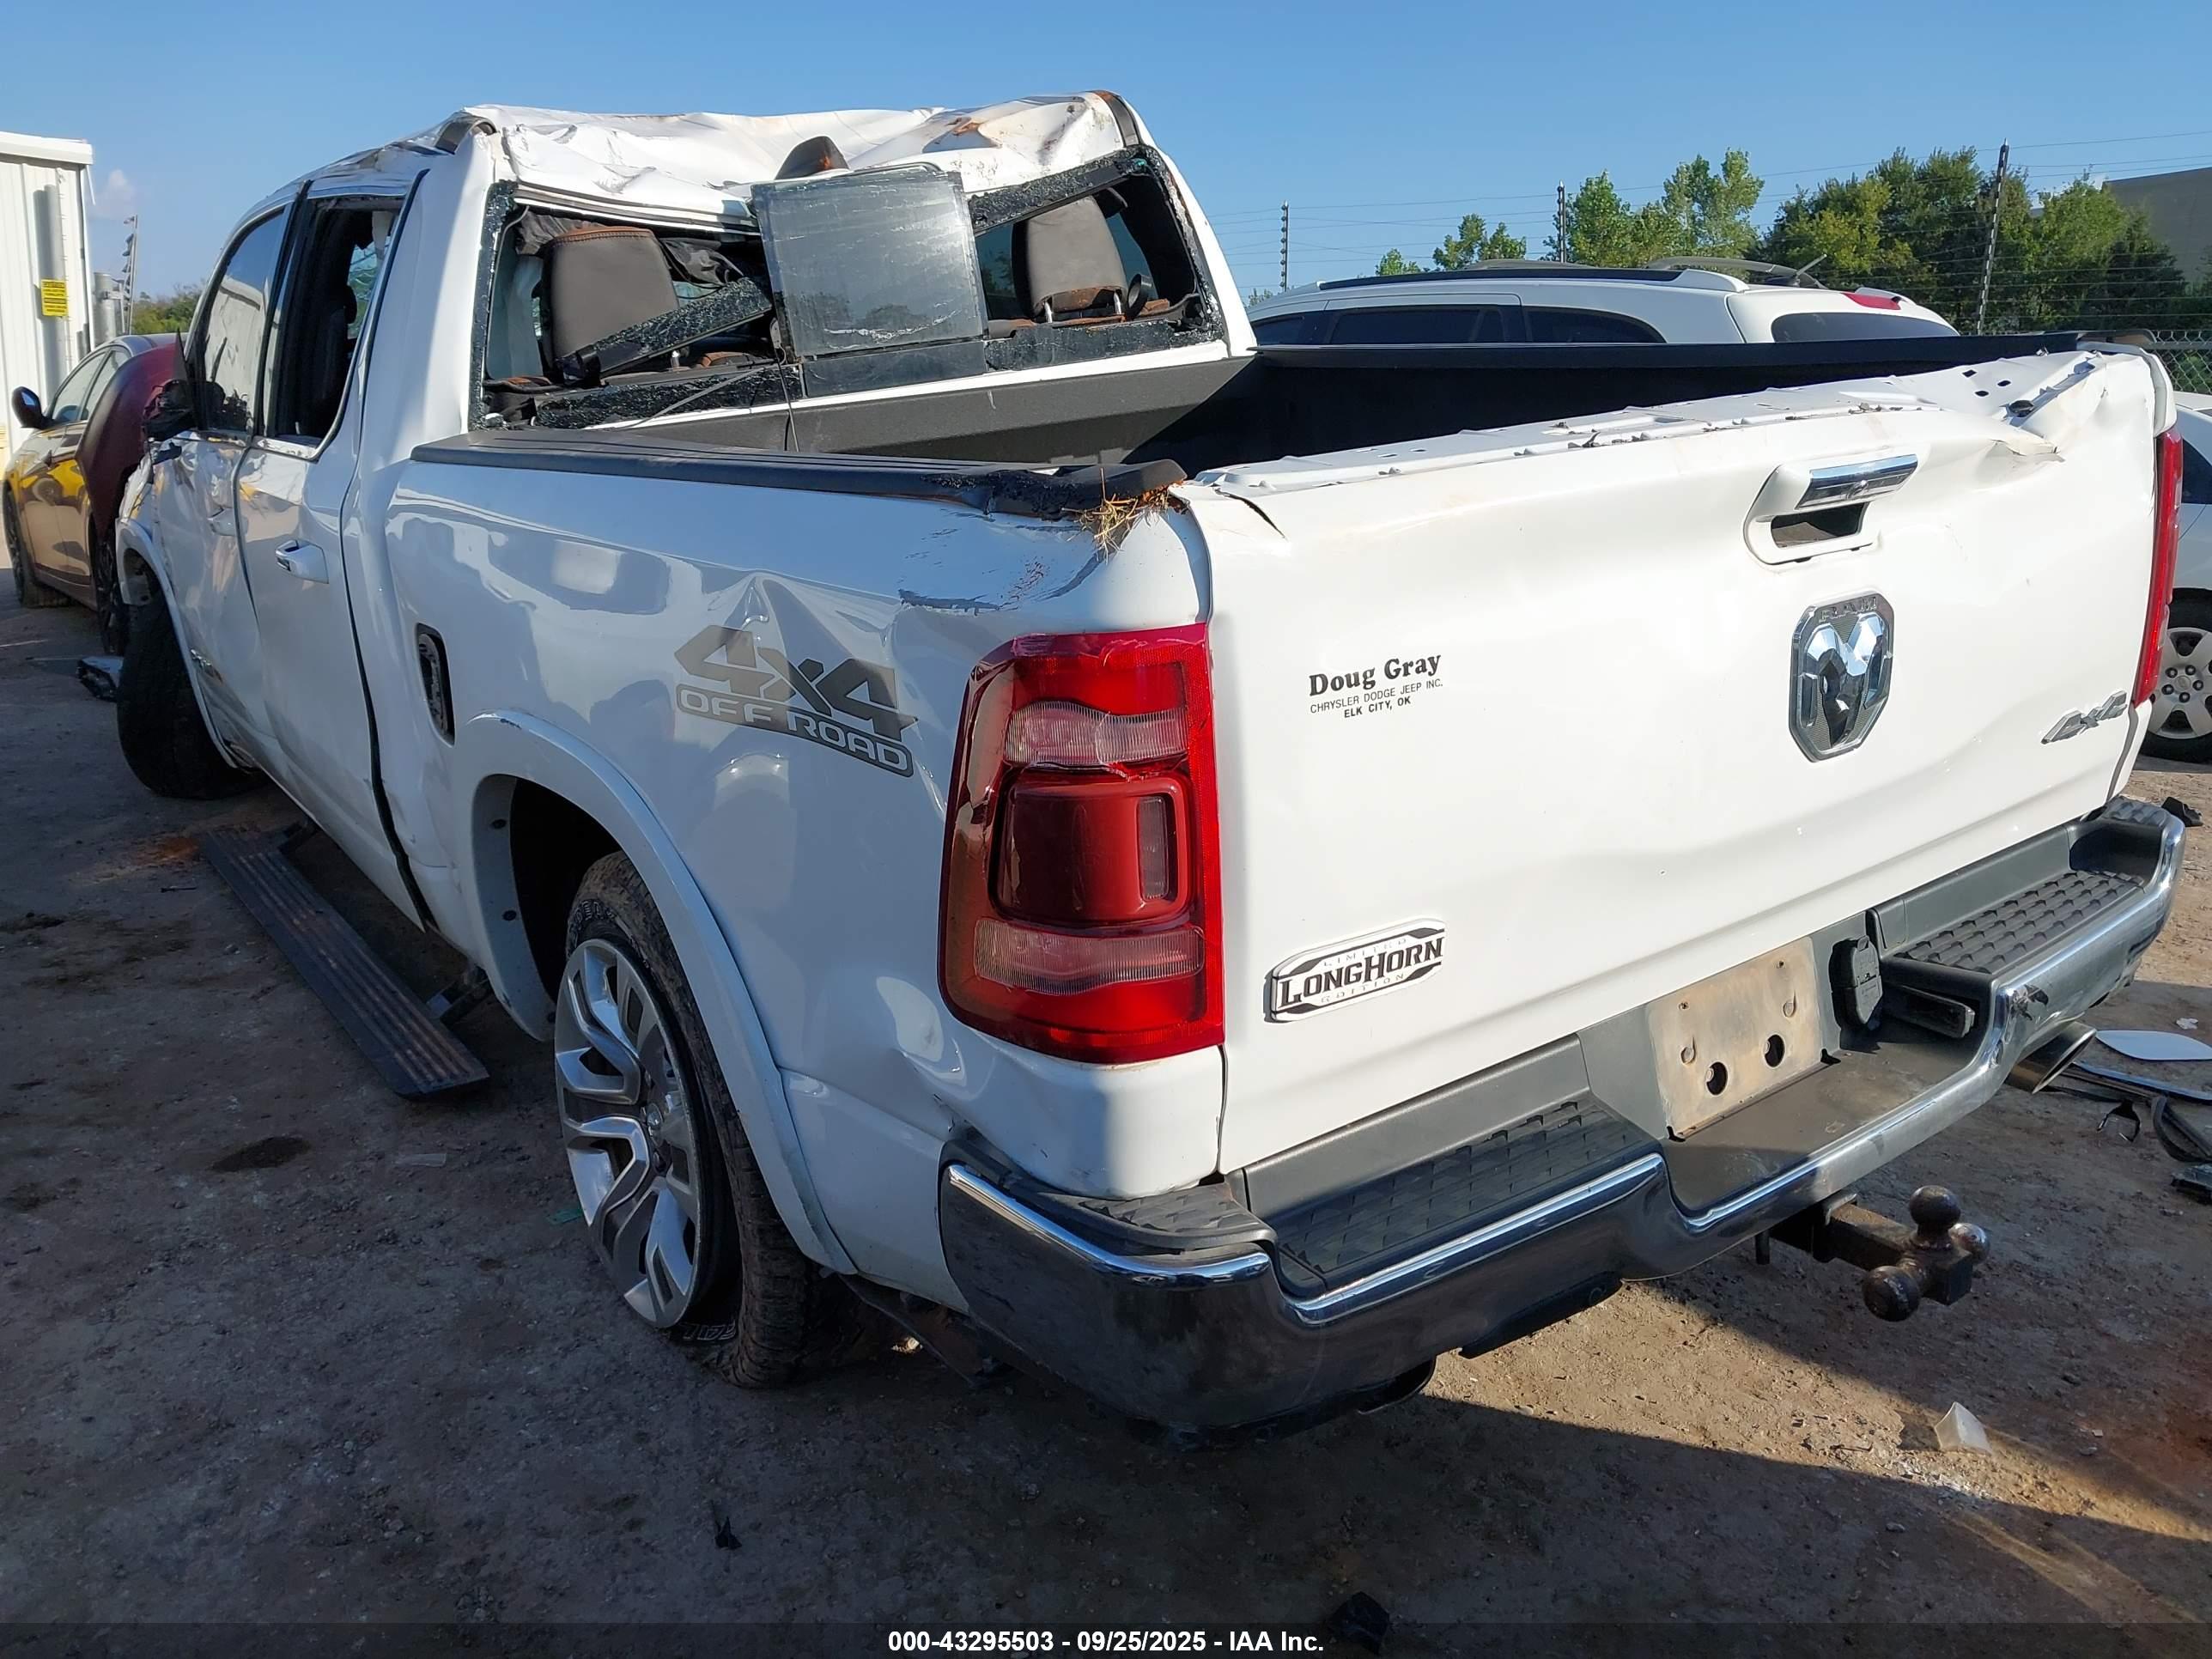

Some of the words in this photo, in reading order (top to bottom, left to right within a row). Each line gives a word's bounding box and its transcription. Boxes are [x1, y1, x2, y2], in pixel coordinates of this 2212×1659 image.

[1819, 596, 1877, 623] RAM
[1310, 667, 1376, 696] Doug
[1384, 654, 1442, 680] Gray
[1310, 696, 1359, 714] CHRYSLER
[1364, 688, 1396, 702] DODGE
[1400, 682, 1422, 696] JEEP
[1426, 678, 1443, 690] INC.
[1345, 706, 1363, 719] ELK
[1368, 700, 1393, 714] CITY,
[1397, 696, 1412, 706] OK
[680, 689, 775, 723] OFF
[787, 710, 908, 772] ROAD
[1279, 937, 1445, 1008] LONGHORN
